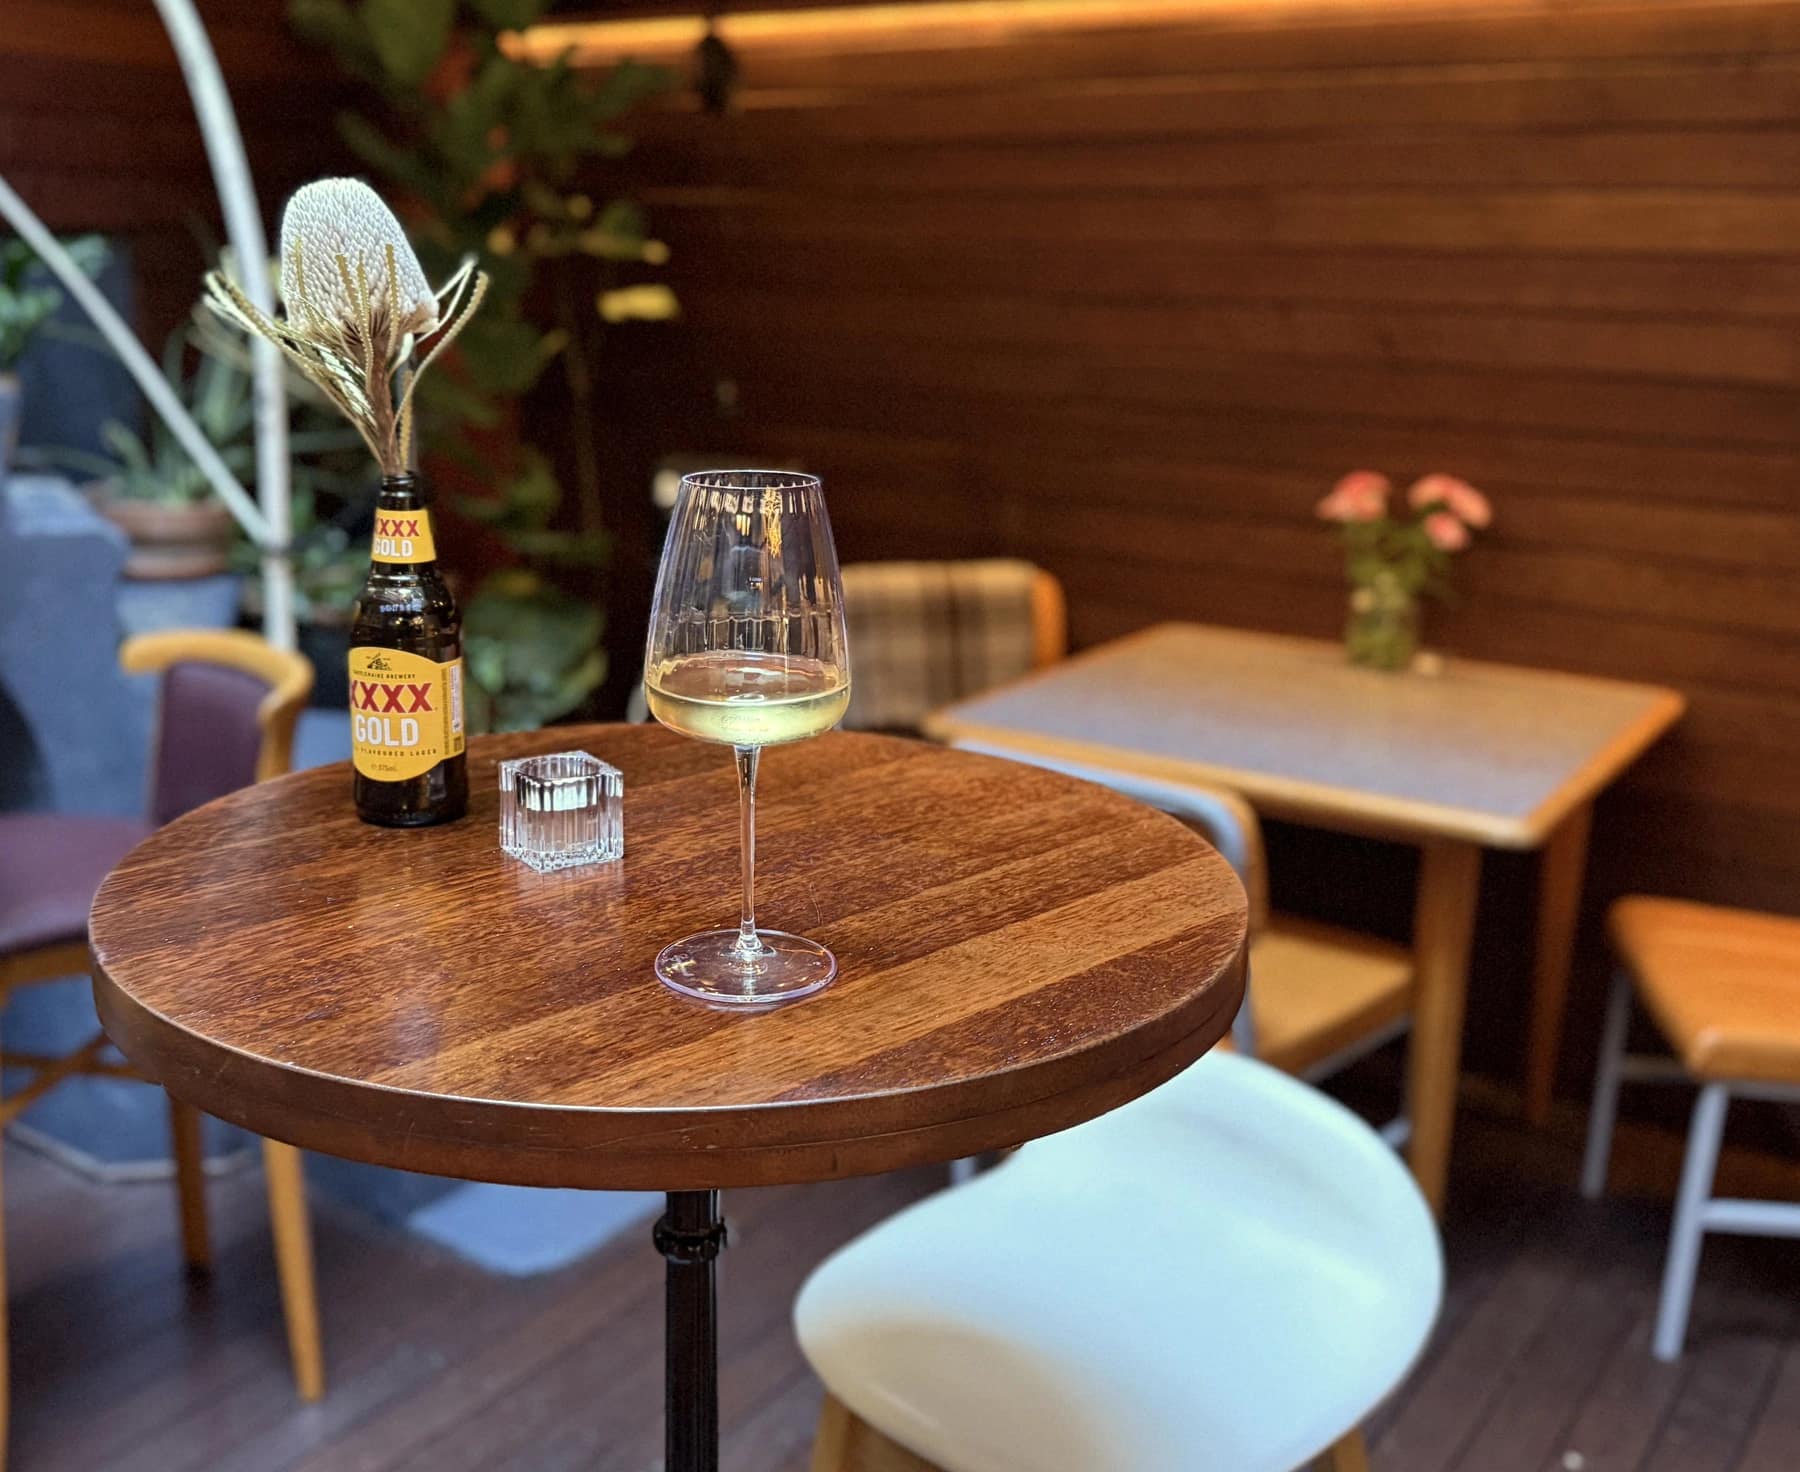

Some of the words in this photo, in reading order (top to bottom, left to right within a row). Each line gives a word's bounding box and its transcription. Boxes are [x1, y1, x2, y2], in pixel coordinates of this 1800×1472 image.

[376, 518, 420, 537] XXX
[374, 537, 413, 557] GOLD
[355, 714, 419, 746] GOLD
[409, 748, 437, 756] LAGER
